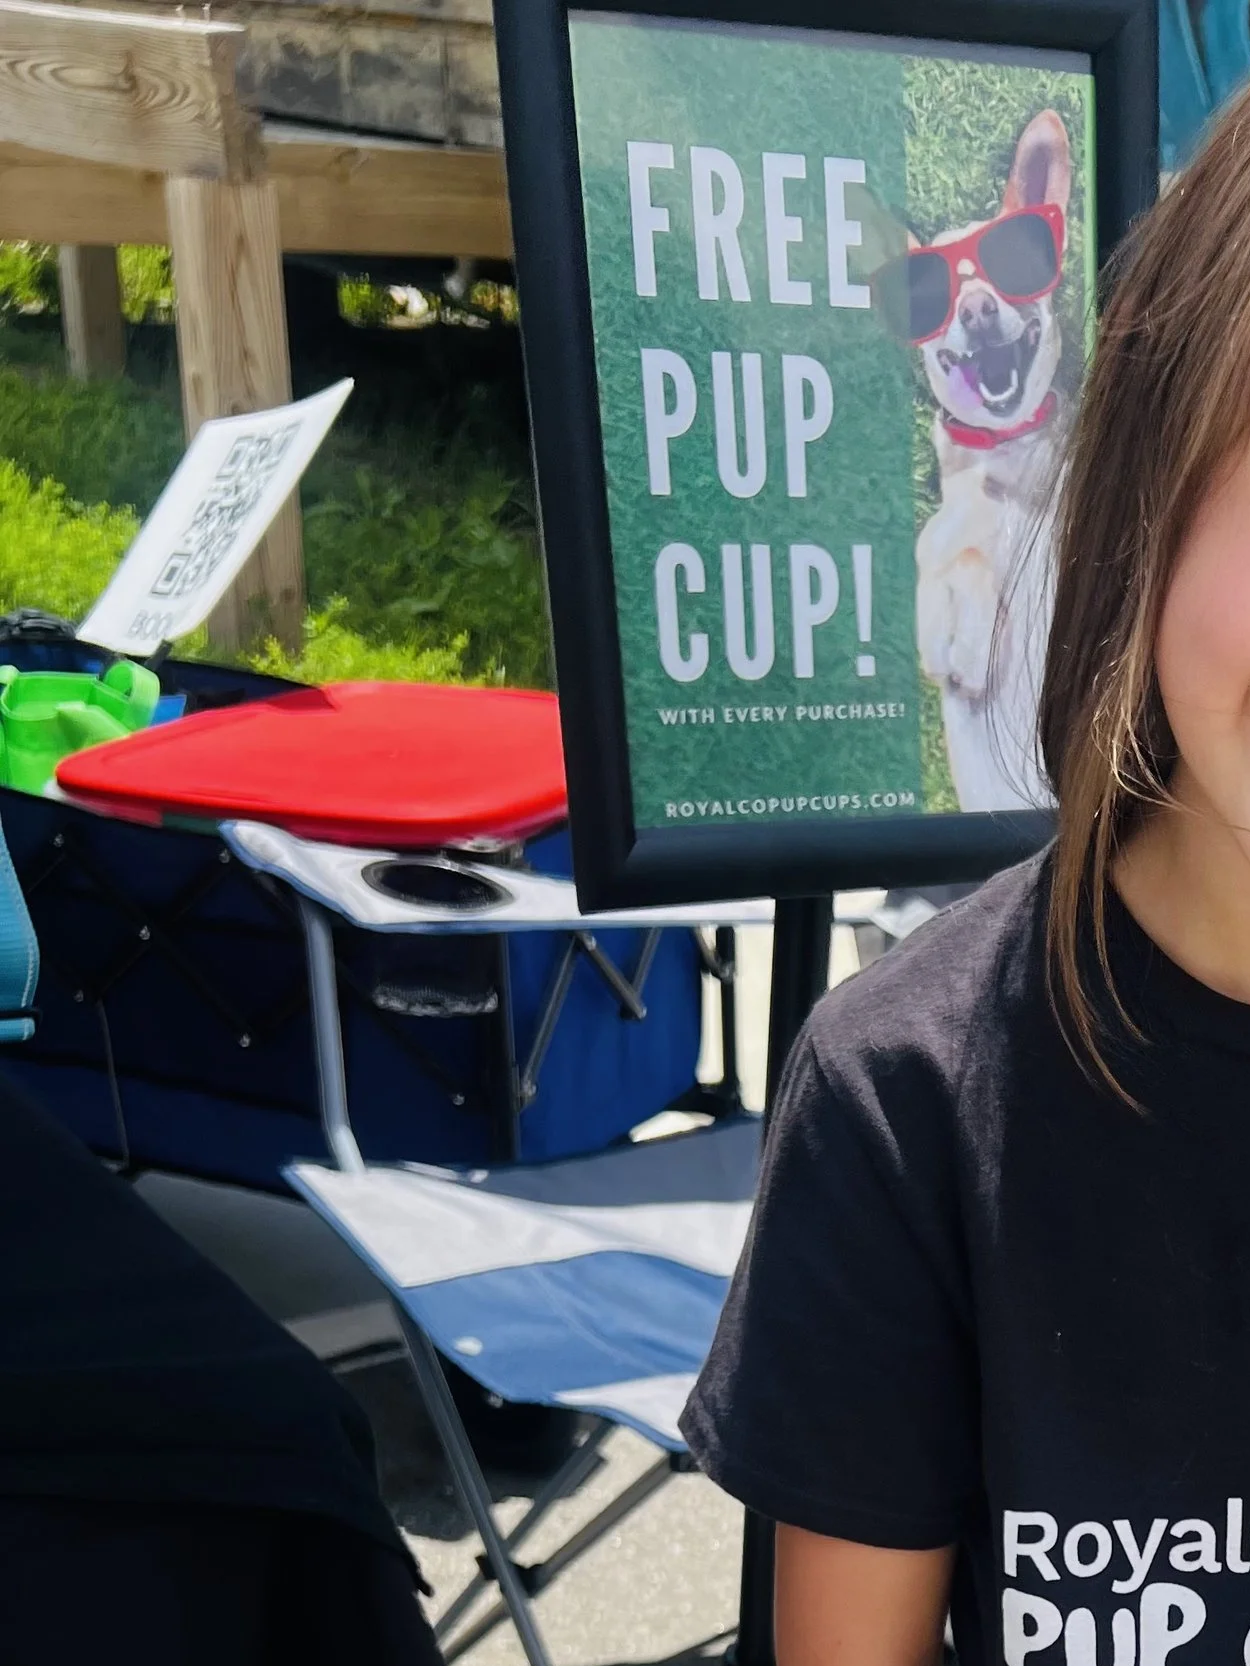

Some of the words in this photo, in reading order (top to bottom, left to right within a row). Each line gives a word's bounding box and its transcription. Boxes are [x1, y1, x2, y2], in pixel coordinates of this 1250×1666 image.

[626, 140, 871, 309] FREE
[641, 347, 834, 499] PUP
[653, 541, 877, 683] CUP!
[657, 707, 715, 725] WITH
[723, 705, 788, 724] EVERY
[795, 702, 905, 721] PURCHASE!
[665, 792, 915, 818] ROYALCOPUPCUPS.COM
